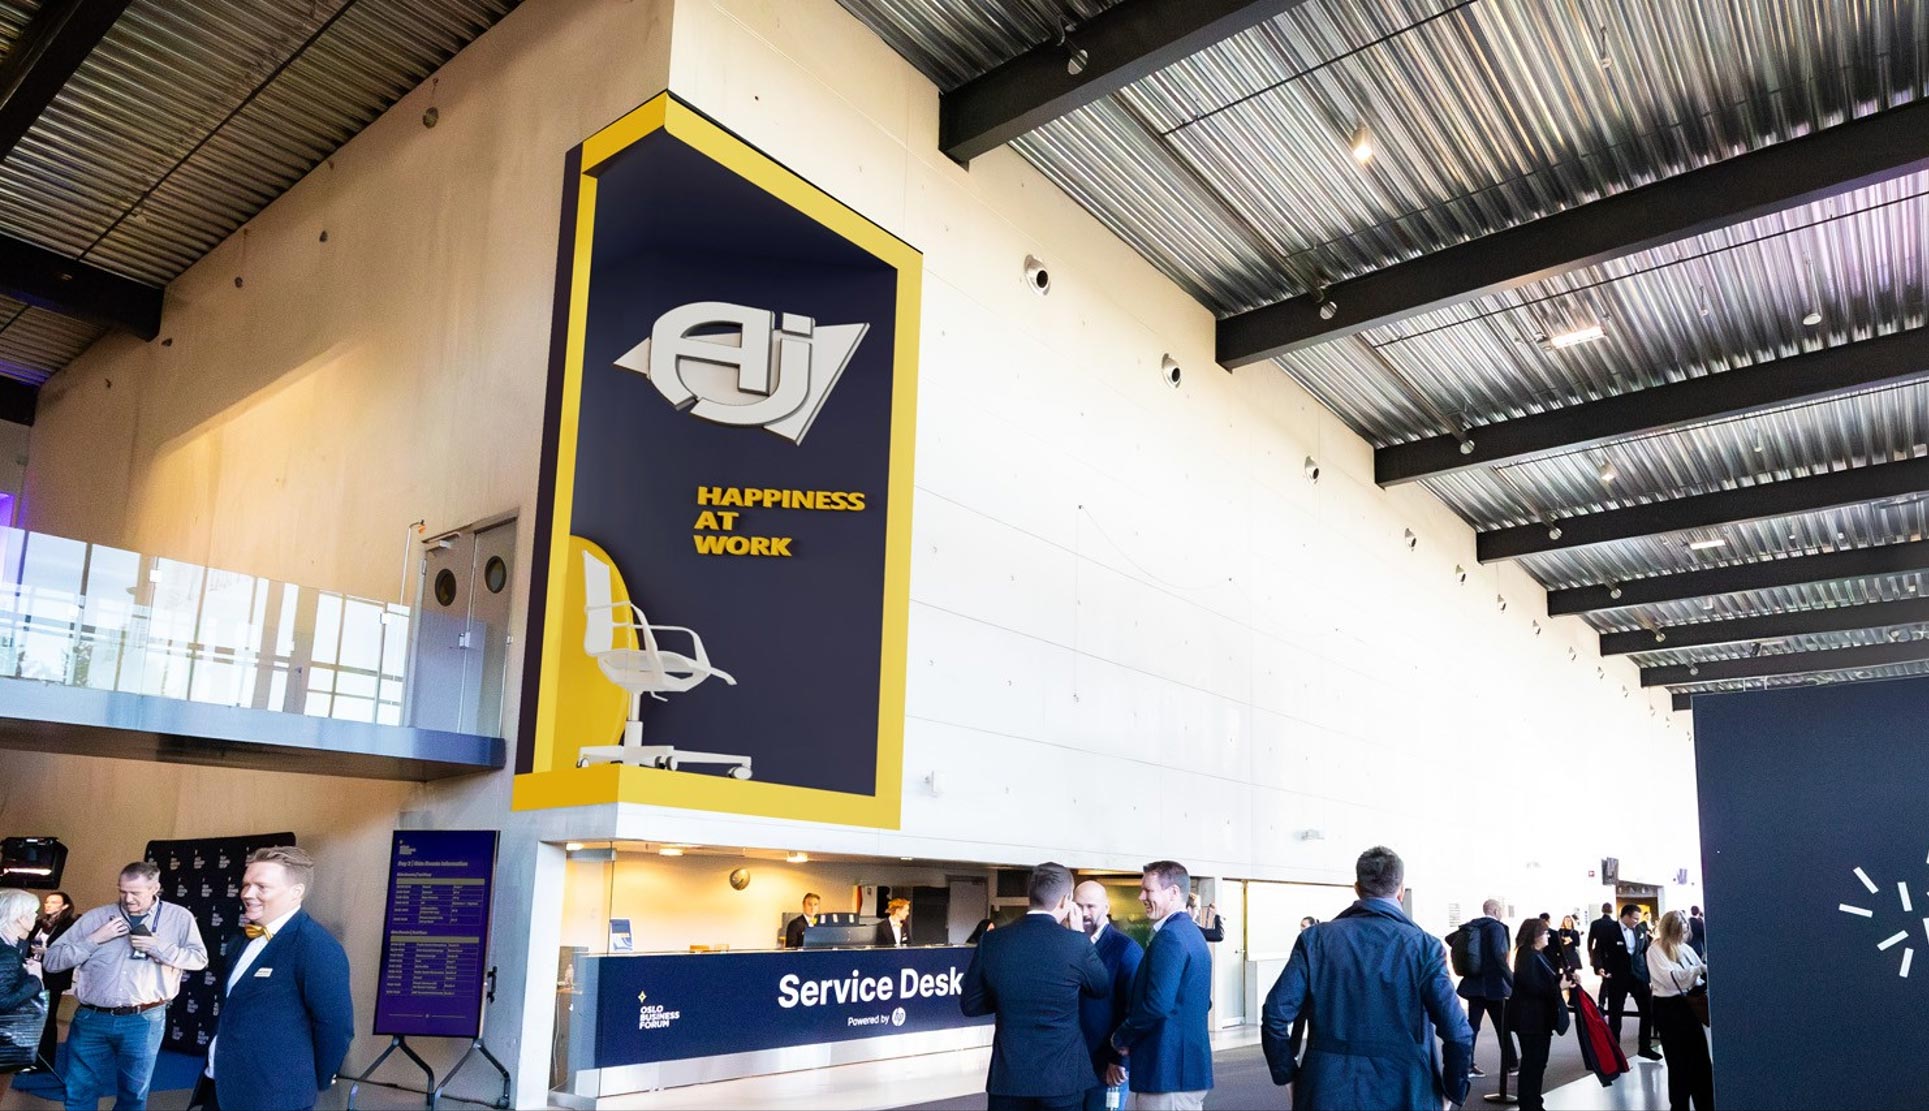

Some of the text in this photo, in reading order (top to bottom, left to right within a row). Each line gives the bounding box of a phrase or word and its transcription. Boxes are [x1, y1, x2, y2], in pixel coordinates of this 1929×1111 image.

[697, 486, 866, 512] HAPPINESS
[694, 511, 739, 531] AT
[693, 535, 793, 558] WORK
[777, 966, 965, 1009] Service Desk
[640, 1005, 664, 1014] OSLO
[640, 1011, 680, 1021] BUSINESS
[639, 1020, 670, 1030] FORUM
[847, 1015, 880, 1027] Powered
[881, 1015, 890, 1025] by
